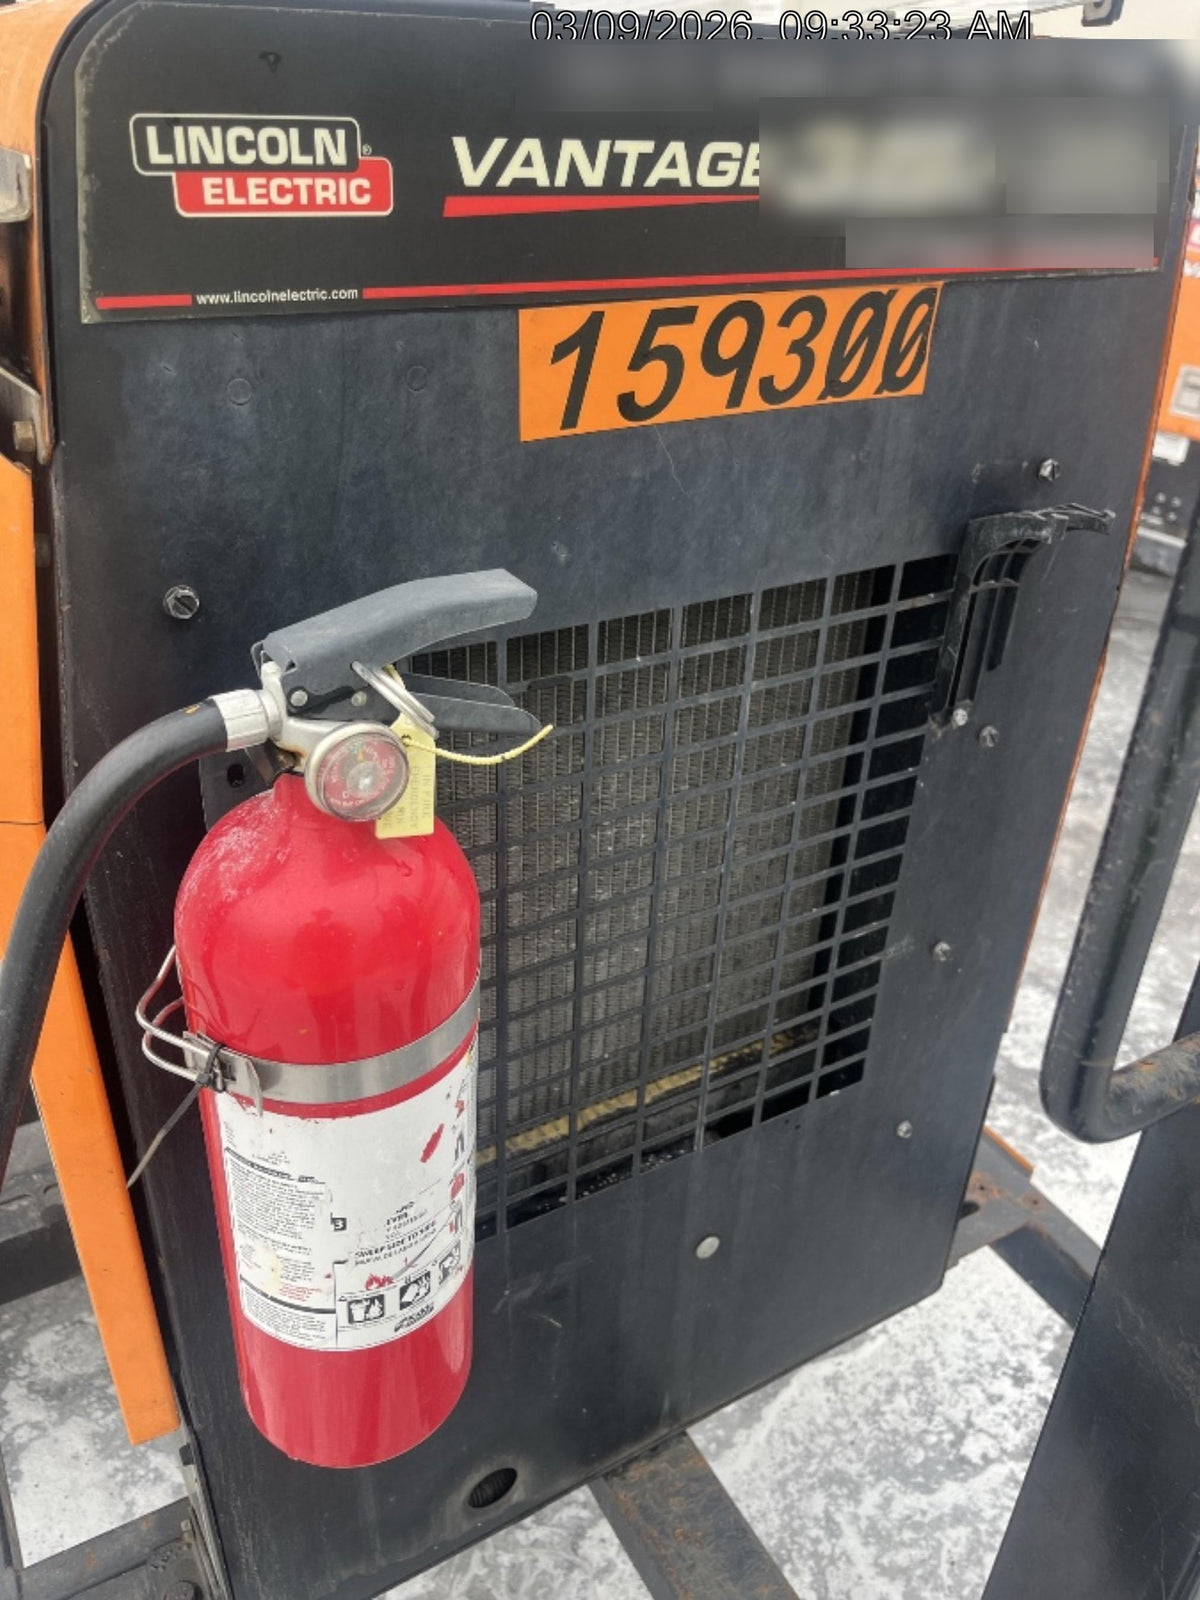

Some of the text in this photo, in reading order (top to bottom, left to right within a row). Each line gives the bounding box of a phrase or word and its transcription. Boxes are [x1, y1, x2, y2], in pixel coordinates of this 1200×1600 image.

[145, 125, 348, 166] LINCOLN
[202, 176, 372, 206] ELECTRIC
[196, 287, 359, 306] www.lincolnelectric.com
[550, 287, 939, 431] 159300
